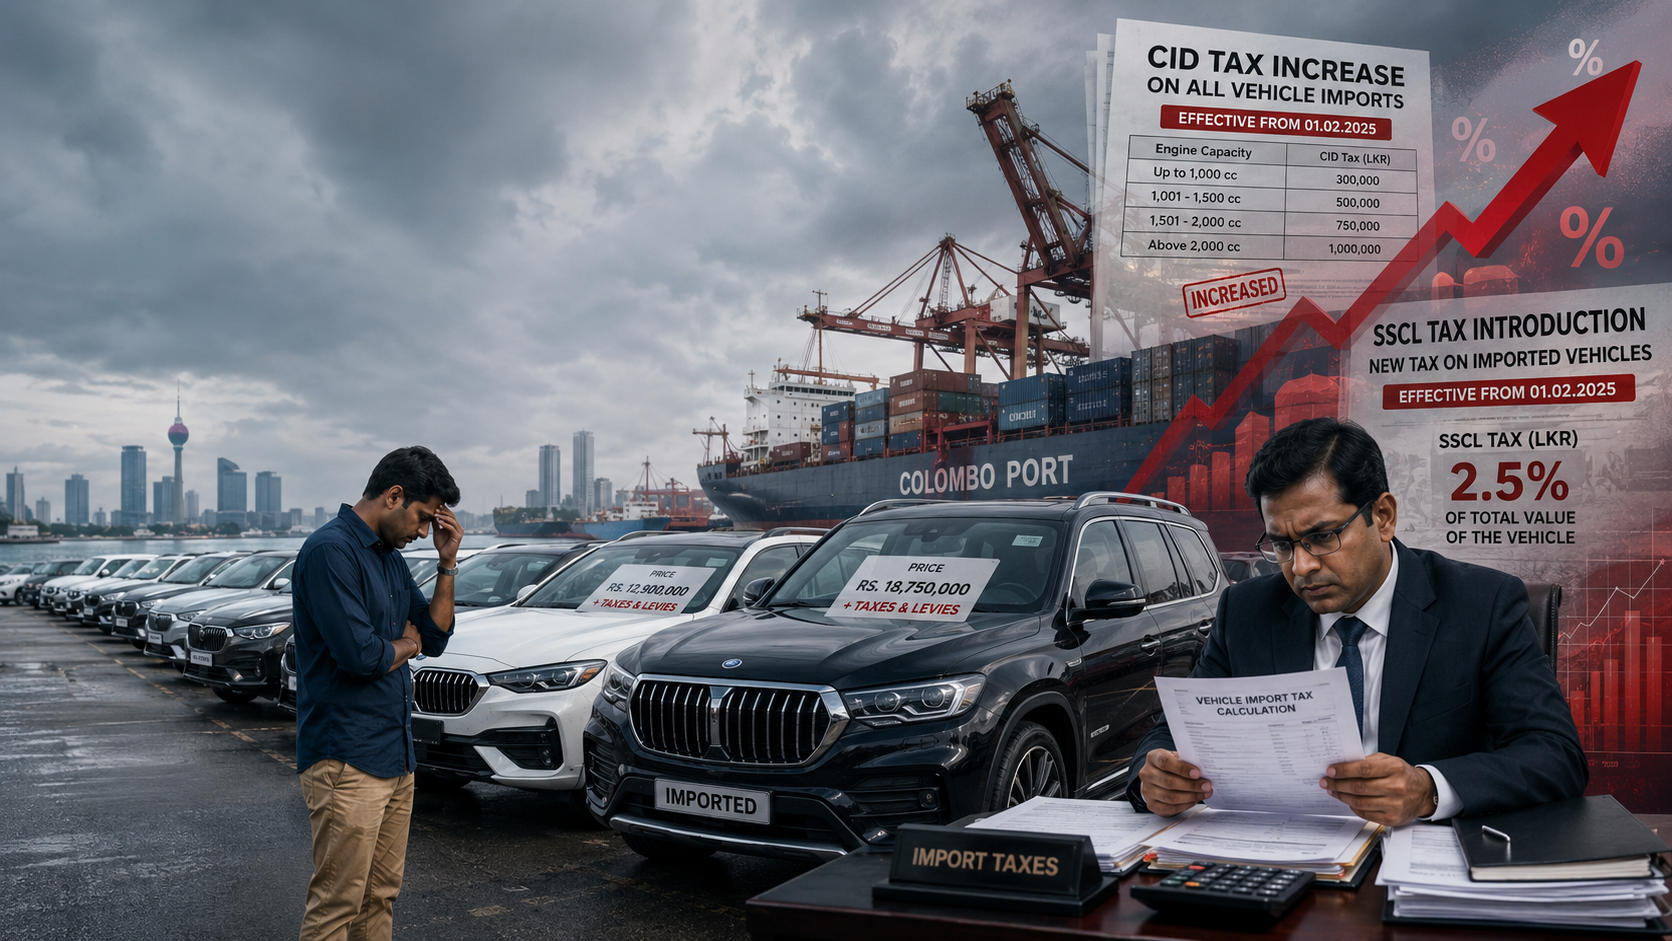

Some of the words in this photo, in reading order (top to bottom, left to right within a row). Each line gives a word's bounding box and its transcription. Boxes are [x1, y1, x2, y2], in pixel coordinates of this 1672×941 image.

[1147, 45, 1199, 70] CID
[1208, 50, 1265, 76] TAX
[1272, 55, 1405, 87] INCREASE
[1147, 76, 1180, 94] ON
[1186, 79, 1226, 98] ALL
[1231, 82, 1315, 103] VEHICLE
[1321, 88, 1404, 109] IMPORTS
[1179, 111, 1256, 128] EFFECTIVE
[1260, 116, 1300, 130] FROM
[1304, 119, 1376, 135] 01.02.2025
[1155, 144, 1197, 158] Engine
[1201, 146, 1252, 160] Capacity
[1320, 152, 1339, 162] CID
[1342, 152, 1360, 163] Tax
[1363, 153, 1391, 165] (LKR)
[1153, 167, 1171, 180] Up
[1174, 168, 1186, 178] to
[1190, 169, 1220, 181] 1,000
[1224, 172, 1237, 180] cc
[1336, 175, 1380, 187] 300,000
[1151, 191, 1181, 203] 1,001
[1194, 192, 1224, 204] 1,500
[1228, 195, 1241, 204] cc
[1336, 197, 1380, 209] 500,000
[1150, 215, 1180, 227] 1,501
[1191, 216, 1224, 228] 2,000
[1228, 219, 1241, 228] cc
[1336, 220, 1380, 232] 750,000
[1148, 239, 1187, 251] Above
[1190, 240, 1223, 253] 2,000
[1227, 243, 1240, 252] cc
[1328, 244, 1381, 255] 1,000,000
[1191, 276, 1279, 310] INCREASED
[1373, 322, 1422, 347] SSCL
[1427, 318, 1467, 343] TAX
[1473, 306, 1646, 340] INTRODUCTION
[1369, 357, 1404, 374] NEW
[1409, 355, 1439, 372] TAX
[1443, 353, 1468, 370] ON
[1473, 349, 1561, 369] IMPORTED
[1565, 344, 1652, 365] VEHICLES
[1399, 387, 1477, 404] EFFECTIVE
[1480, 385, 1525, 400] FROM
[1529, 381, 1617, 400] 01.02.2025
[1439, 433, 1483, 449] SSCL
[1487, 432, 1523, 447] TAX
[1528, 430, 1579, 450] (LKR)
[899, 462, 995, 496] COLOMBO
[1006, 454, 1073, 488] PORT
[1450, 460, 1569, 502] 2.5%
[1445, 512, 1467, 524] OF
[1470, 511, 1519, 524] TOTAL
[1523, 511, 1576, 524] VALUE
[1446, 531, 1467, 544] OF
[1471, 531, 1502, 544] THE
[1506, 531, 1576, 544] VEHICLE
[649, 570, 677, 578] PRICE
[908, 563, 945, 573] PRICE
[606, 582, 623, 592] RS.
[626, 584, 689, 596] 12,900,000
[856, 580, 878, 592] RS.
[884, 580, 971, 597] 18,750,000
[601, 599, 631, 609] TAXES
[632, 601, 641, 609] &
[641, 601, 678, 612] LEVIES
[844, 602, 852, 610] +
[854, 601, 897, 613] TAXES
[898, 602, 909, 614] &
[911, 603, 961, 615] LEVIES
[1196, 696, 1243, 705] VEHICLE
[1245, 693, 1288, 704] IMPORT
[1291, 691, 1313, 701] TAX
[1217, 704, 1296, 716] CALCULATION
[665, 787, 757, 815] IMPORTED
[911, 845, 990, 871] IMPORT
[993, 852, 1059, 877] TAXES
